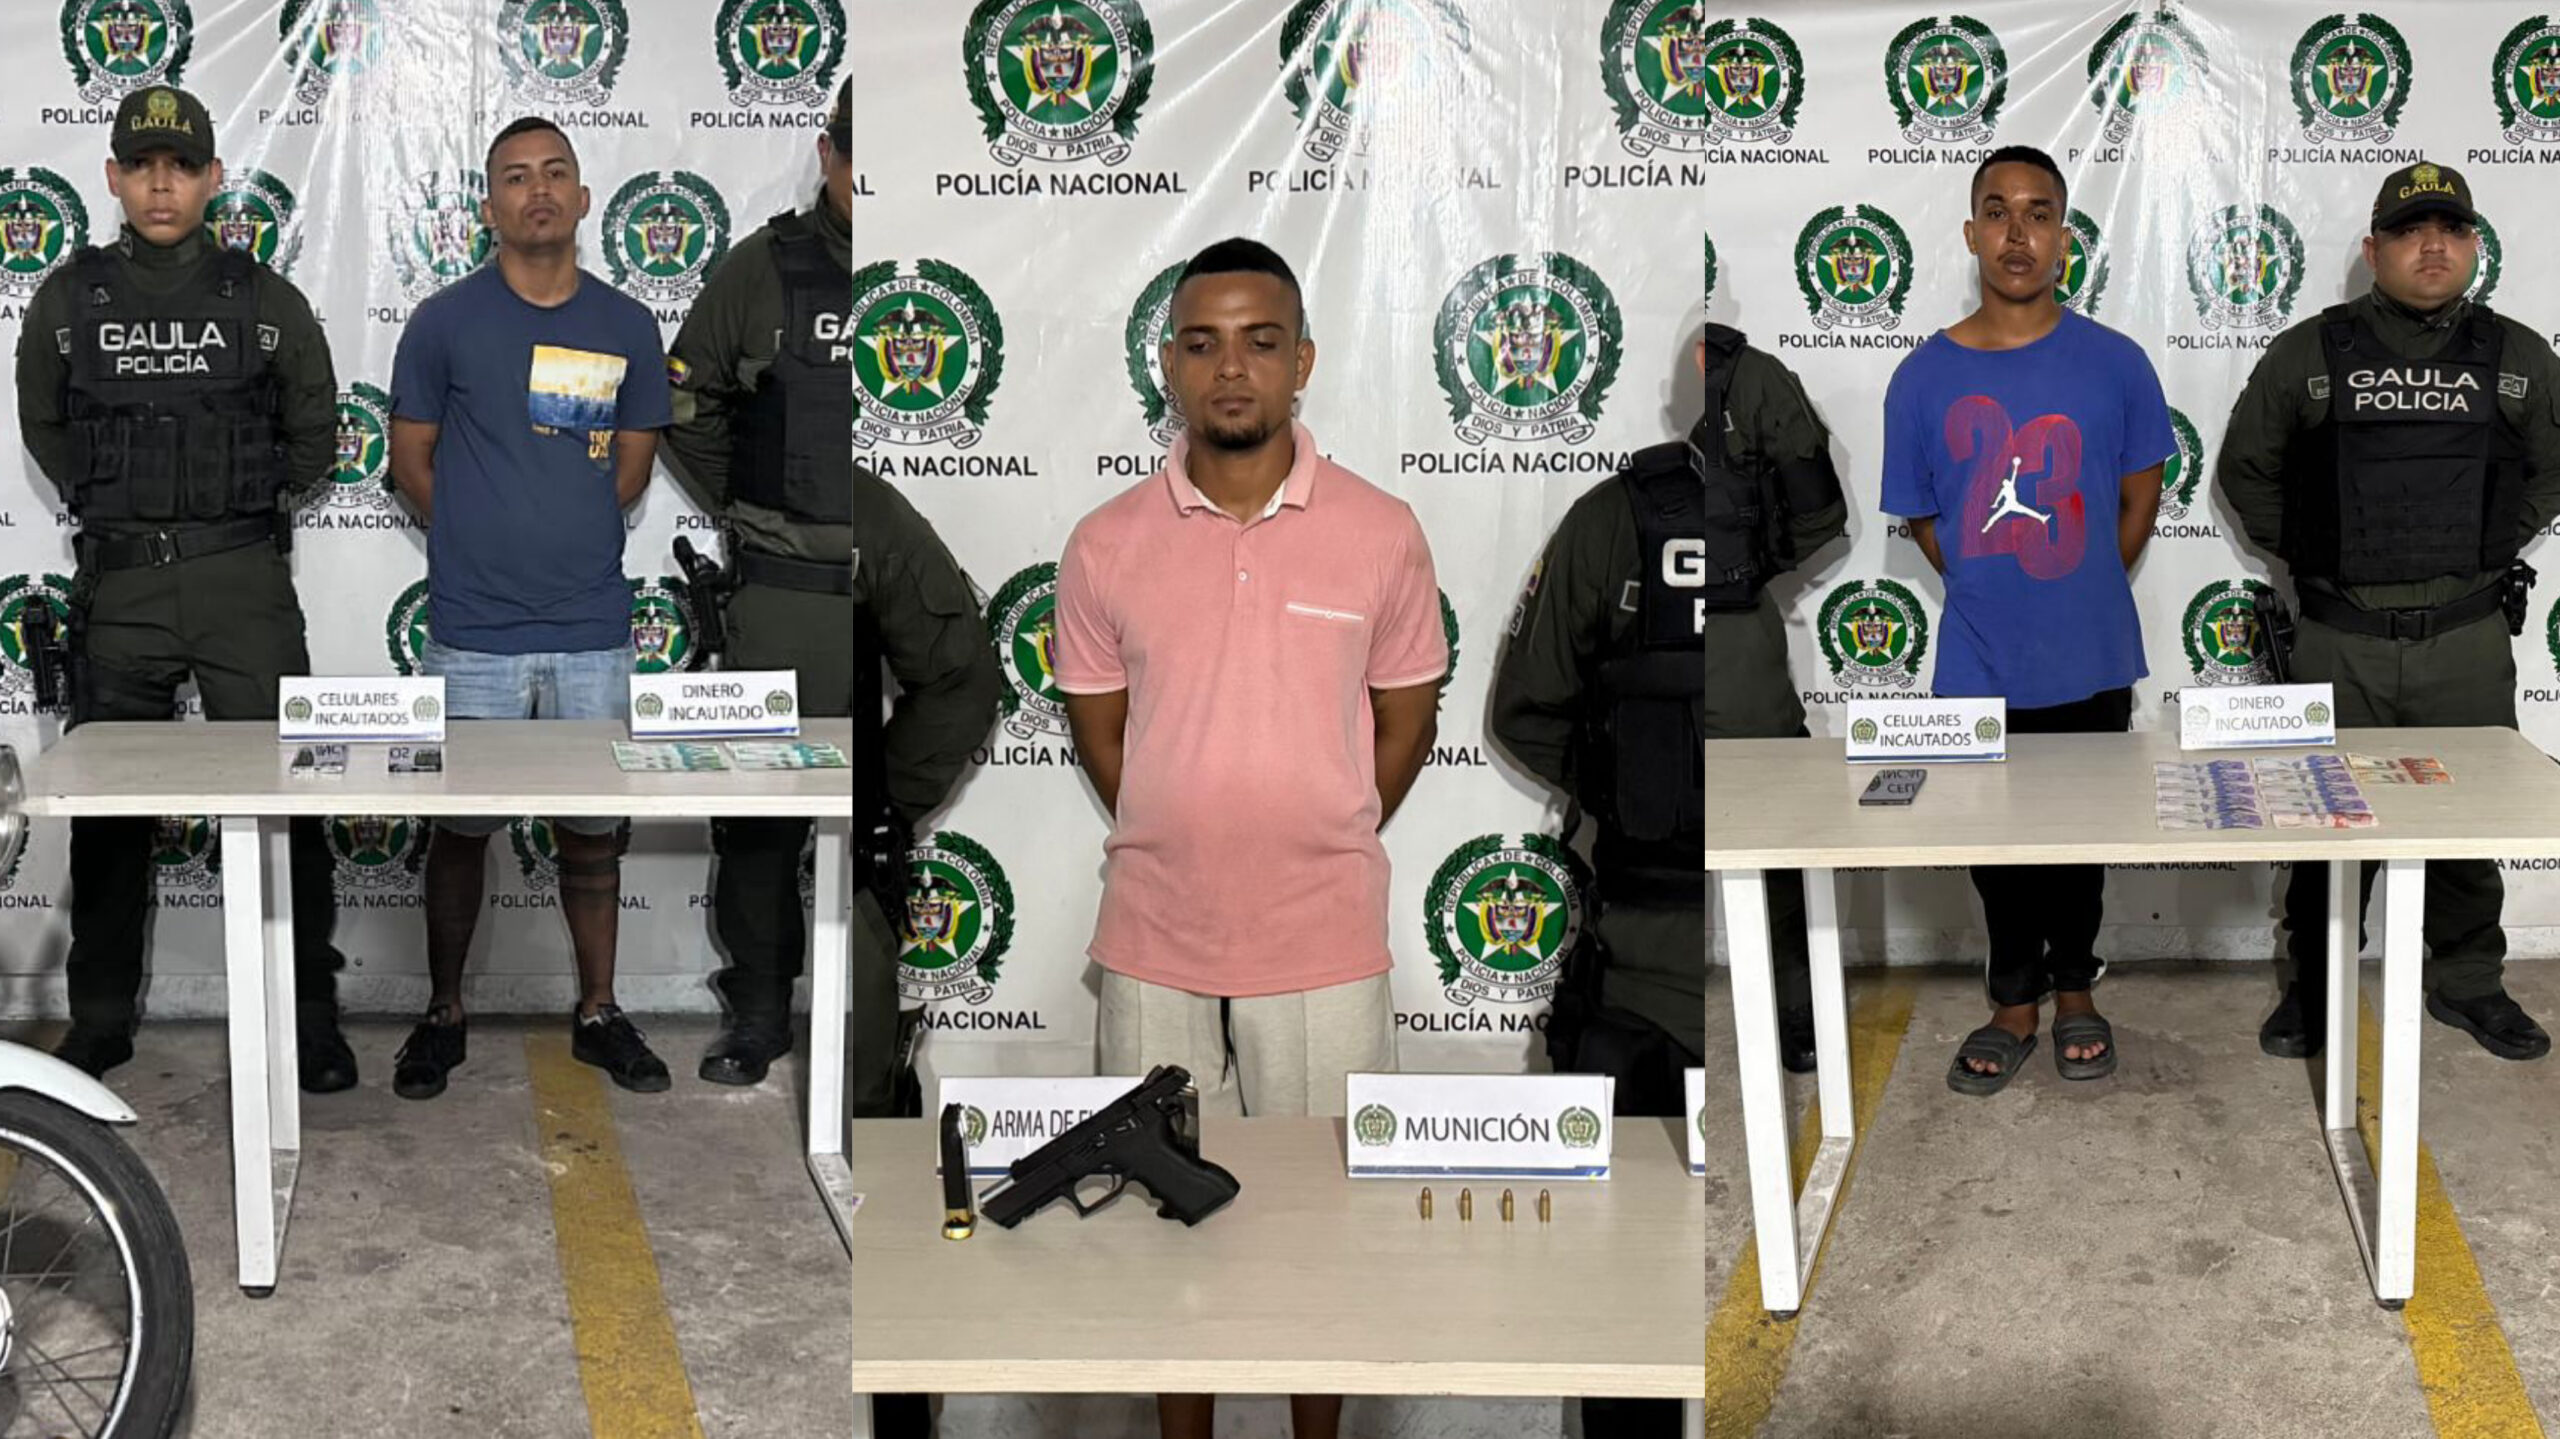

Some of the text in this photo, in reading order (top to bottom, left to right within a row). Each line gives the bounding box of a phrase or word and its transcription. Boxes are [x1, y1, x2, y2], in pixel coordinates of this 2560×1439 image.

[1086, 0, 1128, 54] OLOMBIA
[42, 106, 116, 124] POLICÍA
[553, 110, 649, 128] NACIONAL
[691, 108, 828, 128] POLICÍA NACIO
[1000, 94, 1124, 137] POLICIA NACIONAL
[1634, 89, 1682, 128] POLICIA
[131, 114, 195, 135] GAULA
[1006, 134, 1115, 158] DIOS Y PATRIA
[1638, 124, 1691, 148] DIOS Y
[1741, 149, 1830, 164] NACIONAL
[1868, 146, 1995, 164] POLICÍA NACIO
[2268, 146, 2336, 164] POLICÍA
[2467, 146, 2536, 164] POLICÍA
[936, 169, 1188, 196] POLICÍA NACIONAL
[1564, 161, 1673, 189] POLICÍA
[2400, 180, 2456, 200] GAULA
[368, 308, 407, 323] POLI
[898, 279, 918, 291] DE
[931, 283, 979, 345] COLOMBIA
[1518, 273, 1537, 284] DE
[1551, 277, 1597, 340] COLOMBIA
[100, 321, 226, 351] GAULA
[1778, 331, 1928, 349] POLICÍA NACIONA
[2167, 332, 2233, 350] POLICÍA
[116, 350, 210, 375] POLICÍA
[2348, 368, 2480, 390] GAULA
[853, 383, 973, 423] POLICIA NACIONAL
[1467, 378, 1589, 419] POLICIA NACIONAL
[861, 420, 966, 441] DIOS Y PATRIA
[1471, 415, 1579, 437] DIOS Y PATRIA
[903, 456, 1038, 477] NACIONAL
[1401, 447, 1632, 475] POLICÍA NACIONA
[1944, 394, 2086, 580] 23
[290, 510, 428, 529] LICÍA NACIONAL
[2151, 525, 2222, 538] ACIONAL
[1001, 585, 1048, 644] REPUBLICA
[317, 692, 398, 707] CELULARES
[683, 684, 744, 699] DINERO
[1014, 679, 1060, 715] POLICIA
[2524, 689, 2560, 702] POLI
[668, 704, 764, 722] INCAUTADO
[2229, 696, 2285, 711] DINERO
[315, 711, 409, 726] INCAUTADOS
[1021, 711, 1050, 730] DIOS
[1883, 714, 1962, 729] CELULARES
[2215, 716, 2303, 732] INCAUTADO
[1880, 732, 1973, 748] INCAUTADOS
[971, 741, 1053, 766] OLICÍA
[2510, 858, 2560, 870] NACIO
[915, 849, 991, 911] DE COLOMBIA
[1446, 850, 1580, 914] REPUBLICA DE COLOMBIA
[490, 892, 557, 908] POLICÍA
[931, 944, 985, 981] NACIONAL
[1454, 945, 1571, 983] POLICIA NACIONAL
[917, 978, 979, 997] Y PATRIA
[1460, 977, 1489, 997] DIOS
[1499, 987, 1508, 999] Y
[918, 1010, 1047, 1030] NACIONAL
[1395, 1008, 1493, 1032] POLICÍA
[992, 1110, 1045, 1138] ARMA
[1049, 1110, 1074, 1138] DE
[1405, 1113, 1550, 1143] MUNICIÓN
